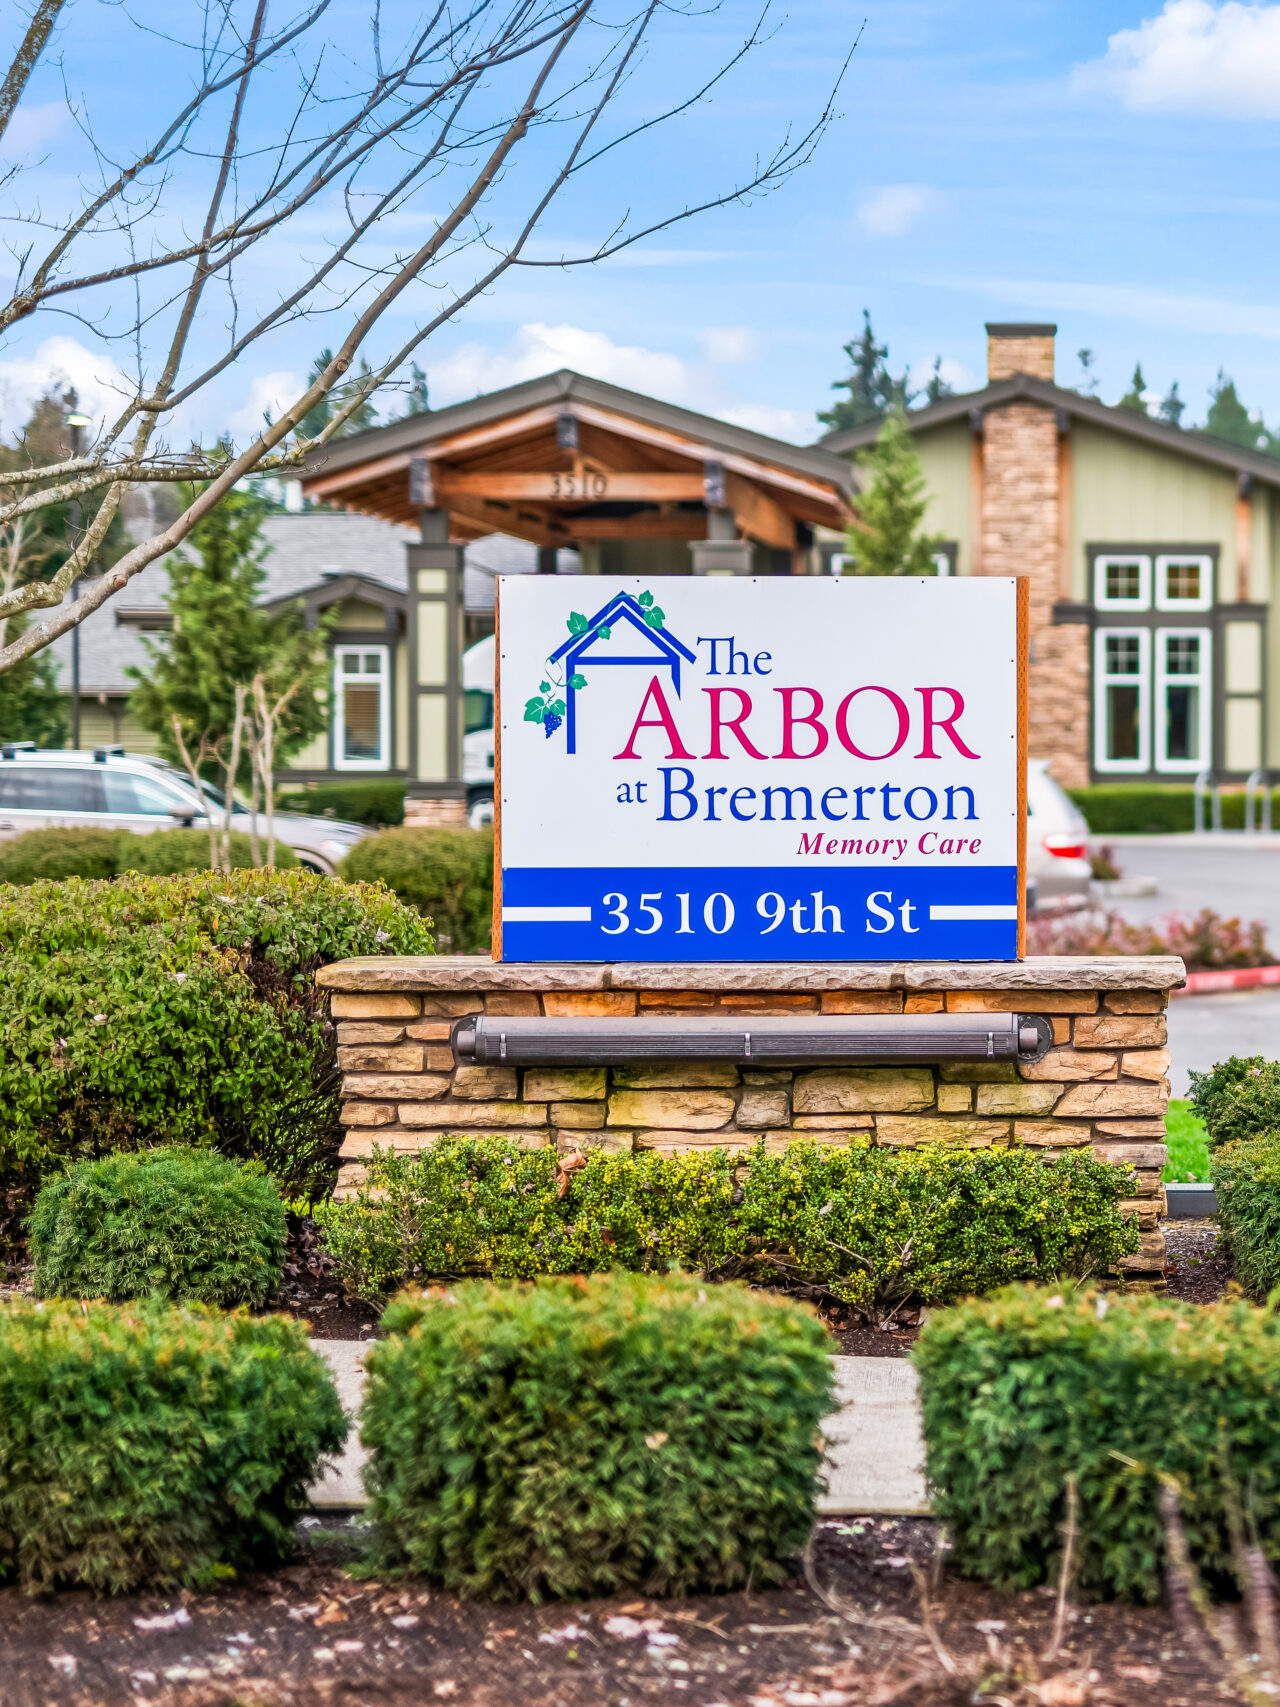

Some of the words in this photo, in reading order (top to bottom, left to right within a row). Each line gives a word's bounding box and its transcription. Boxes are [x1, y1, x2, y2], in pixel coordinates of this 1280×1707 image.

[551, 474, 608, 497] 3510
[697, 636, 773, 675] The
[612, 675, 982, 761] ARBOR
[616, 780, 648, 804] at
[656, 766, 980, 822] Bremerton
[796, 832, 908, 861] Memory
[917, 831, 982, 856] Care
[600, 892, 735, 935] 3510
[756, 890, 845, 935] 9th
[865, 891, 920, 934] St
